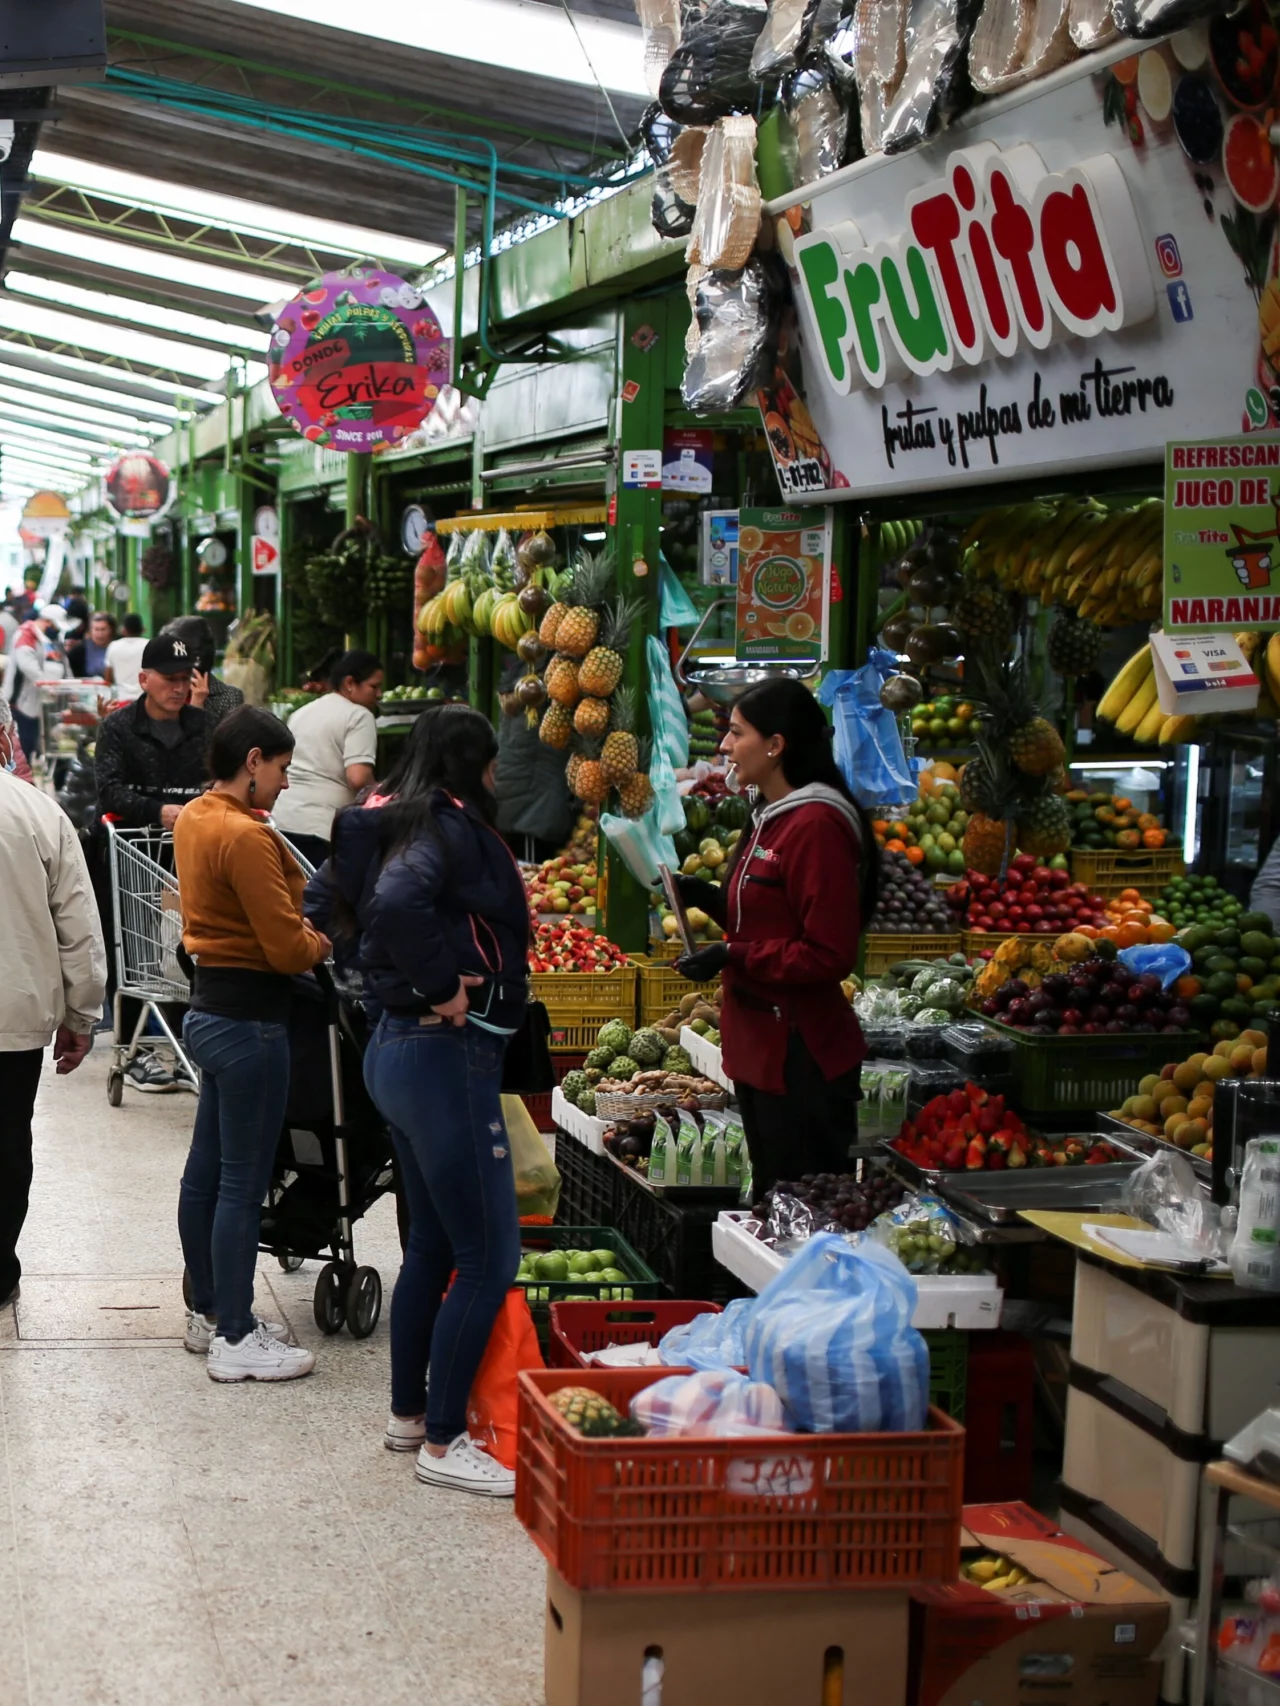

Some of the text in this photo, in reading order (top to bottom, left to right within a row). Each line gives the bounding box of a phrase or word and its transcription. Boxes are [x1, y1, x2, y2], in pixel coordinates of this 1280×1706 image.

[799, 164, 1117, 382] FruTita
[346, 306, 380, 319] PULPAS
[292, 340, 344, 373] DONDE
[316, 365, 416, 410] Erika
[881, 359, 1175, 469] frutas y pulpas de mi tierra
[335, 429, 364, 443] SINCE
[1173, 478, 1269, 508] JUGO DE
[762, 511, 801, 523] FruTita
[1173, 528, 1230, 545] FruTita
[765, 564, 794, 585] Jugo
[756, 578, 802, 596] Natural
[172, 640, 188, 657] NY
[1201, 649, 1227, 657] VISA
[1204, 679, 1228, 687] bold
